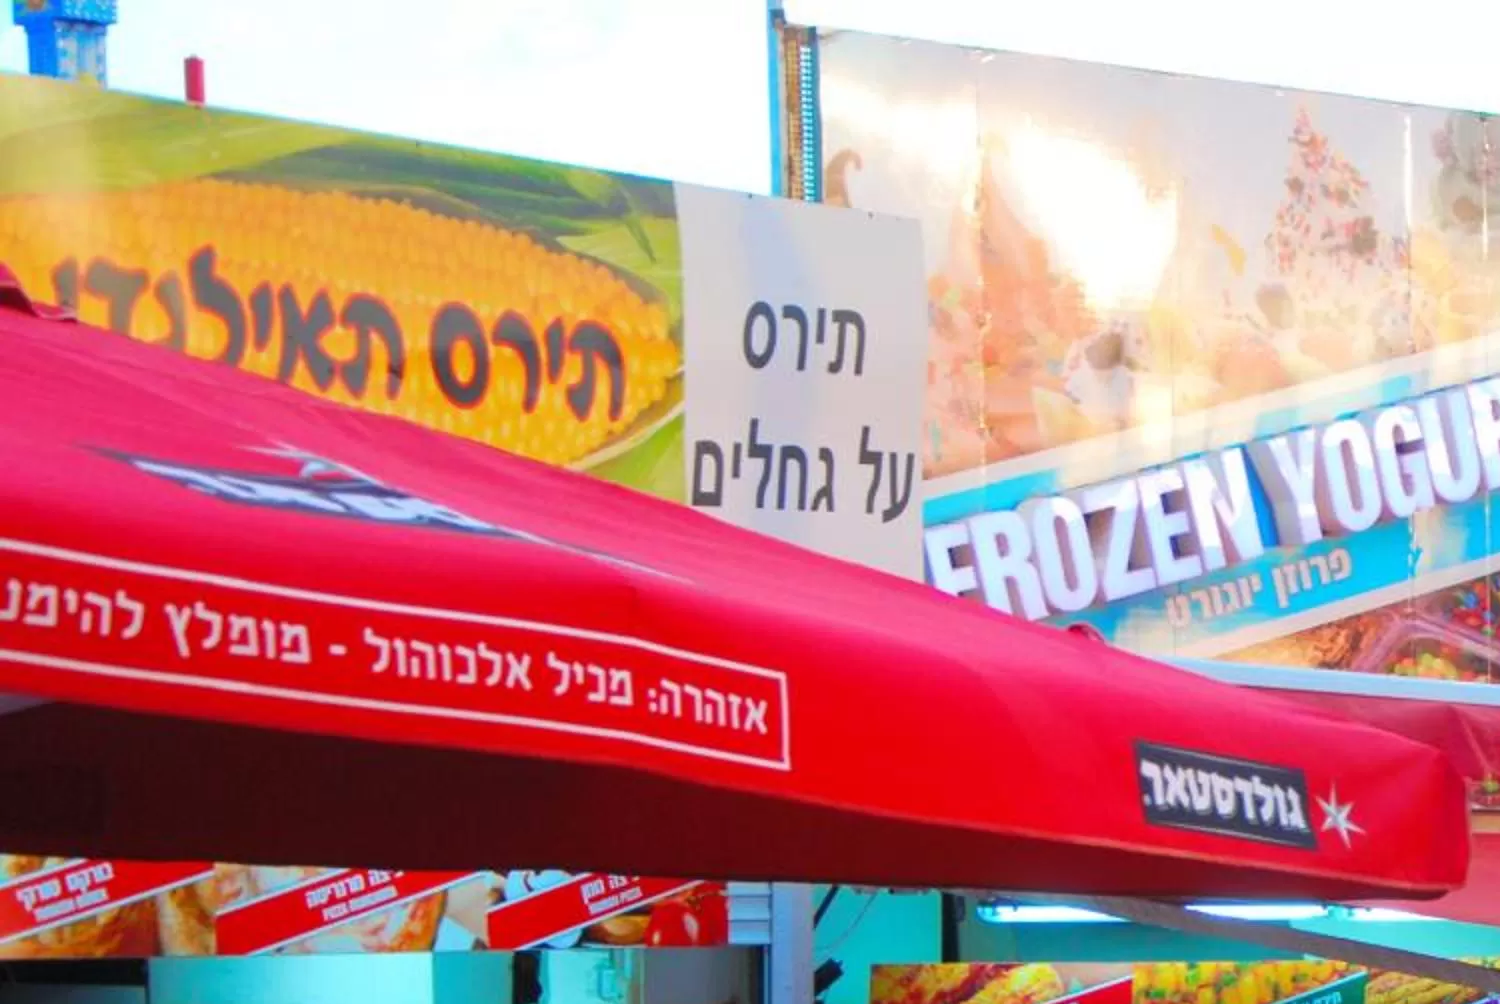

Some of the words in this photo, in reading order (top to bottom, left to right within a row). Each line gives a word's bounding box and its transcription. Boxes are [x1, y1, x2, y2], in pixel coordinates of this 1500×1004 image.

[427, 300, 626, 423] תירס
[742, 300, 867, 377] תירס
[691, 419, 837, 515] גחלים
[857, 428, 917, 526] על
[924, 445, 1268, 620] FROZEN
[1166, 574, 1262, 627] יוגורט
[1272, 547, 1352, 608] פרוזן
[163, 601, 311, 664] מומלץ
[364, 626, 533, 691] אלכוהול
[547, 651, 634, 706] מכיל
[648, 679, 768, 734] אזהרה:
[1140, 758, 1307, 830] גולדסטאר
